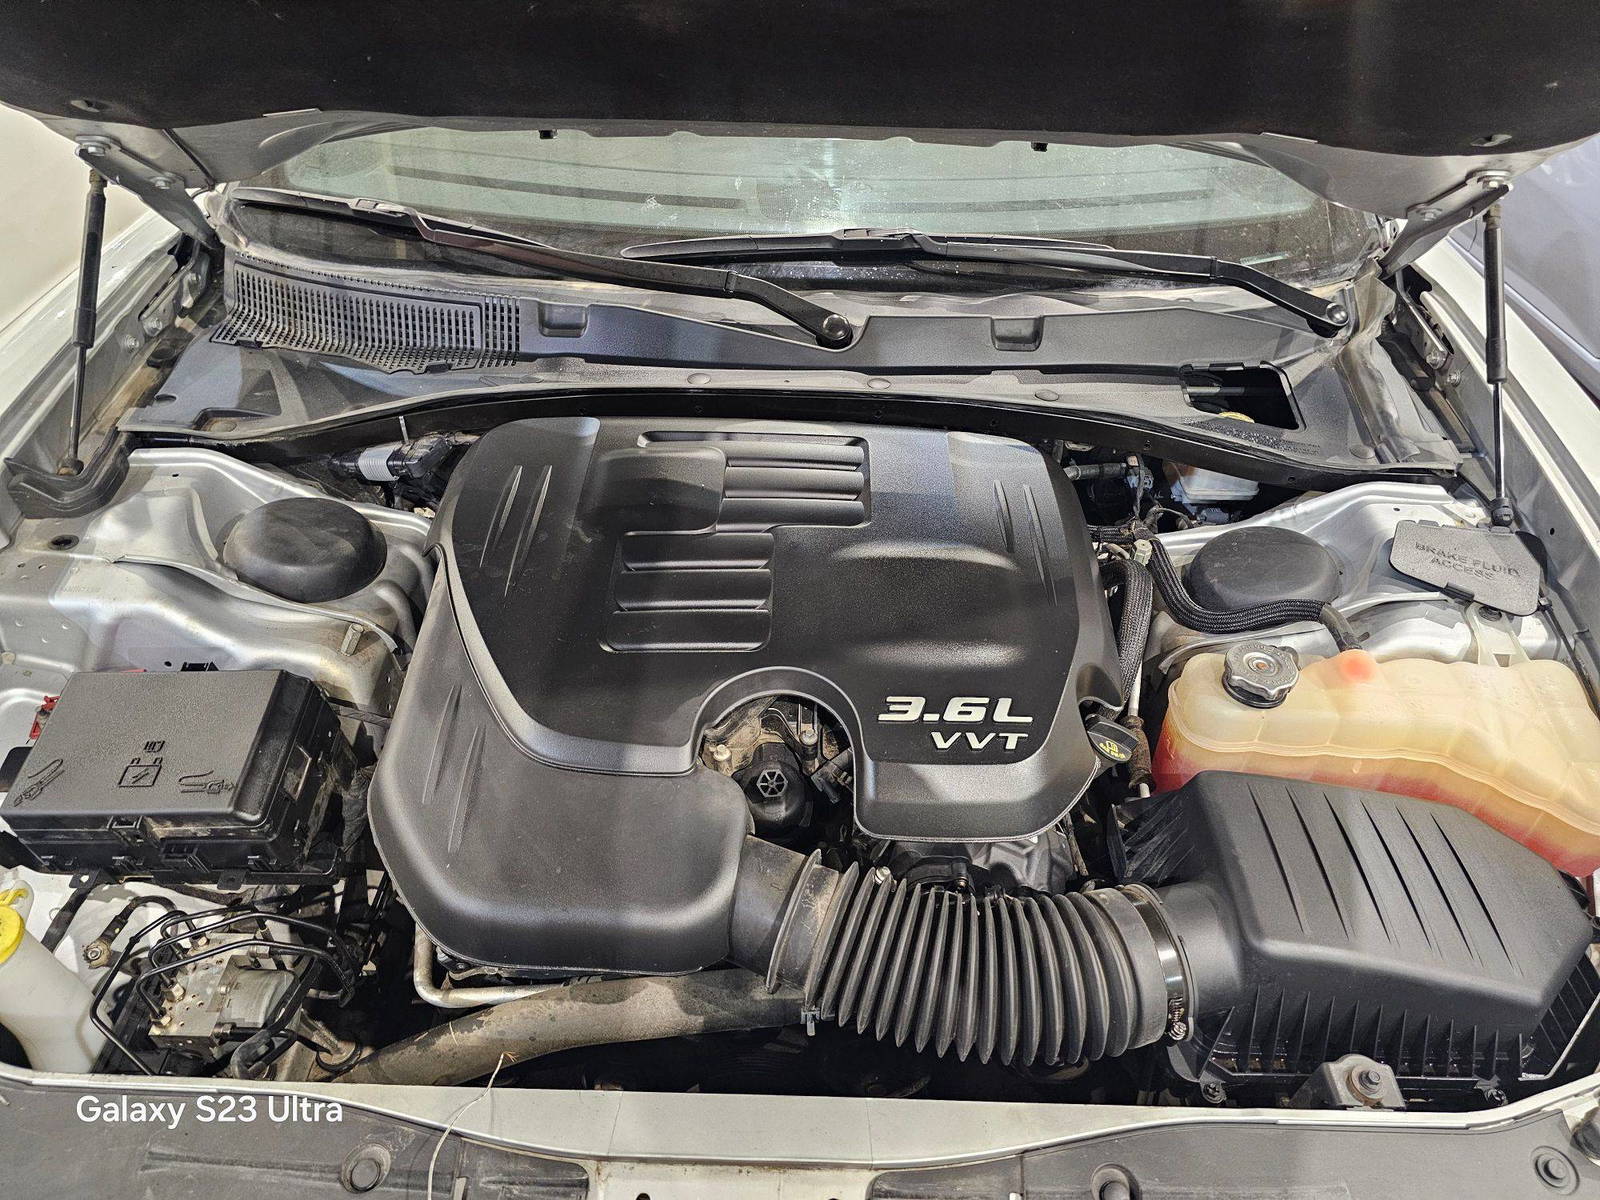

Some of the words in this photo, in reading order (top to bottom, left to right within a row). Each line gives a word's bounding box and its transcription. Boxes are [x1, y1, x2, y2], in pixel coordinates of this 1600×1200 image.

[1415, 541, 1467, 564] BRAKE
[1431, 557, 1496, 580] ACCESS
[877, 696, 1033, 724] 3.6L
[930, 731, 1029, 750] VVT
